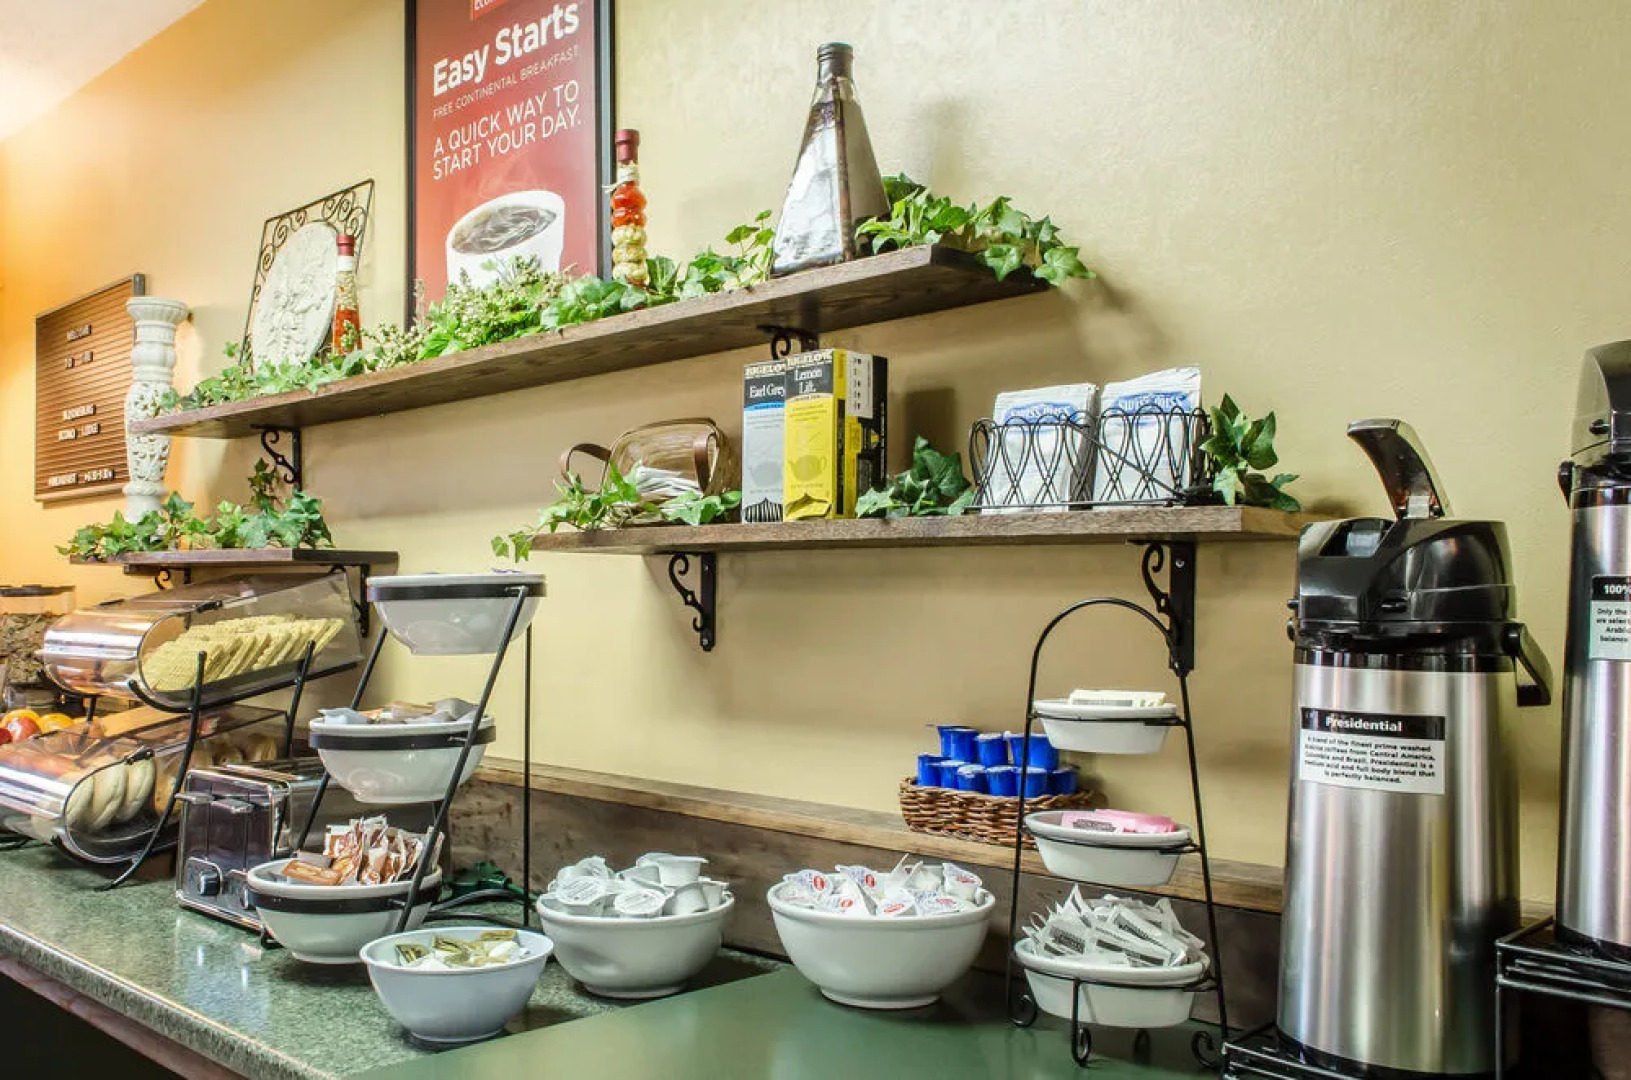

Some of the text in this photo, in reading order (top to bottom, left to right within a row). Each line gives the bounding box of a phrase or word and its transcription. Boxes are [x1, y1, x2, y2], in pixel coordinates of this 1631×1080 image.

[433, 2, 580, 96] Easy Starts
[433, 46, 580, 119] FREE CONTINENTAL BREAKFAST
[433, 80, 579, 157] A QUICK WAY TO
[433, 105, 582, 181] START YOUR DAY.
[794, 369, 823, 381] Lemon
[750, 385, 765, 398] Earl
[1326, 715, 1402, 732] Presidential
[1350, 740, 1372, 748] finest
[1370, 750, 1398, 758] Central
[1370, 759, 1418, 768] Presidential
[1371, 767, 1391, 775] body
